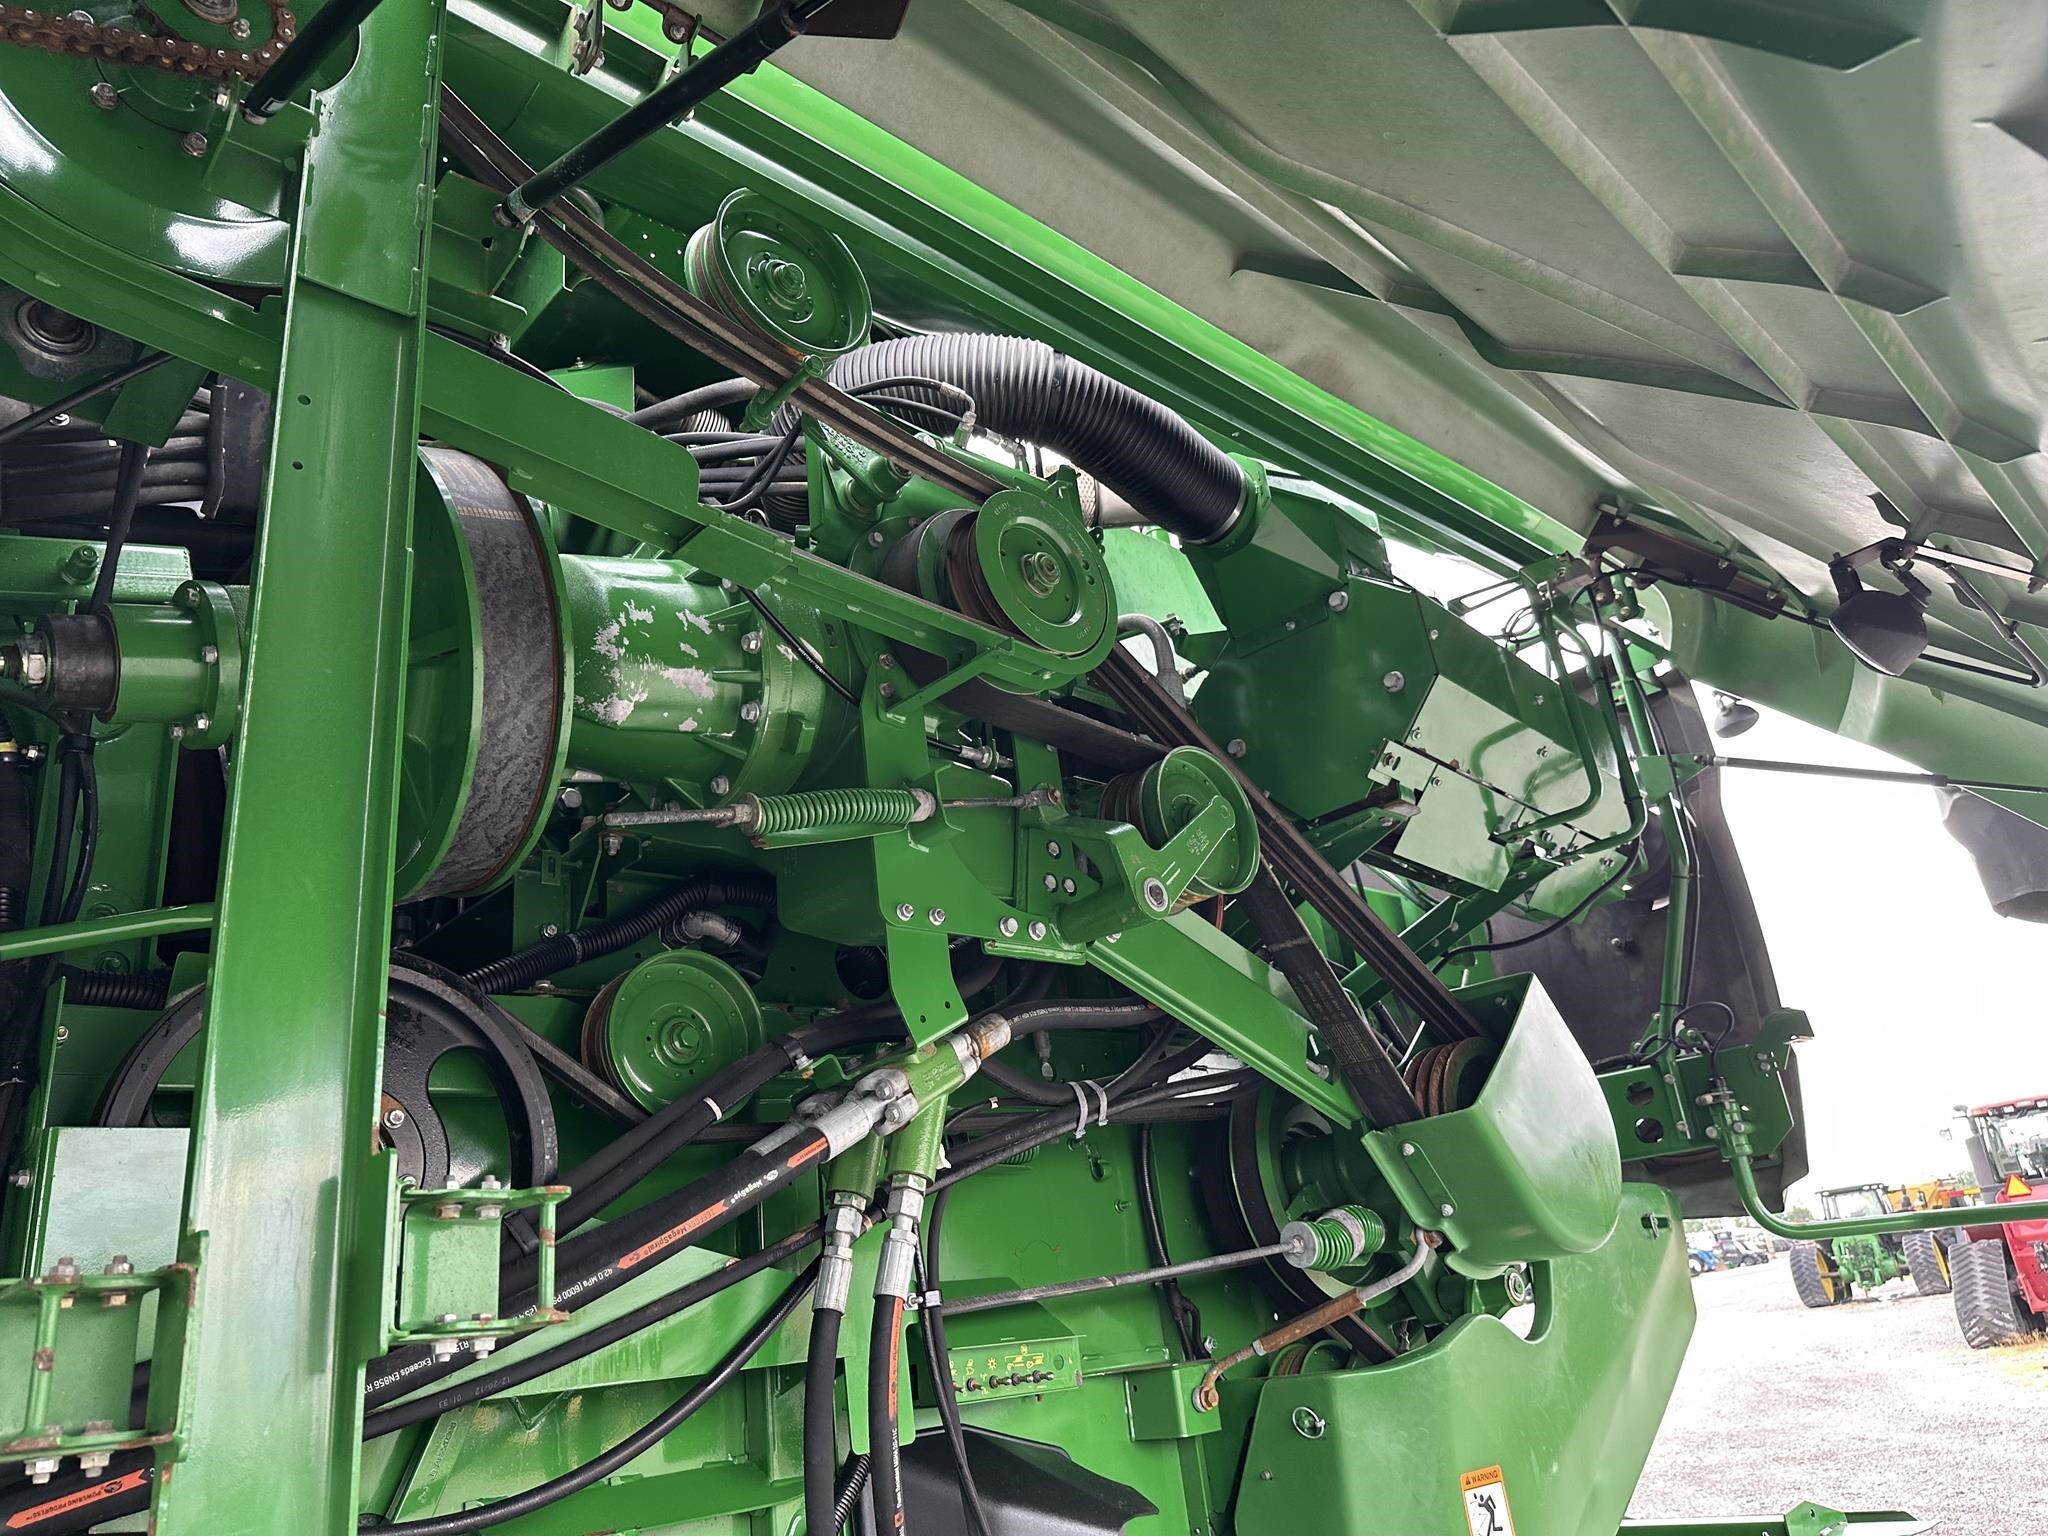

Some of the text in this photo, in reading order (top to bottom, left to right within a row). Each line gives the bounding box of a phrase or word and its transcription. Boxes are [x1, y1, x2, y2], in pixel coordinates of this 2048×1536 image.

[597, 1268, 614, 1281] 42.0
[582, 1275, 599, 1289] MPa
[562, 1281, 583, 1300] (6000
[552, 1293, 563, 1305] PS
[399, 1356, 432, 1377] Exceeds
[373, 1373, 401, 1391] EN856
[1471, 1470, 1498, 1484] WARNING
